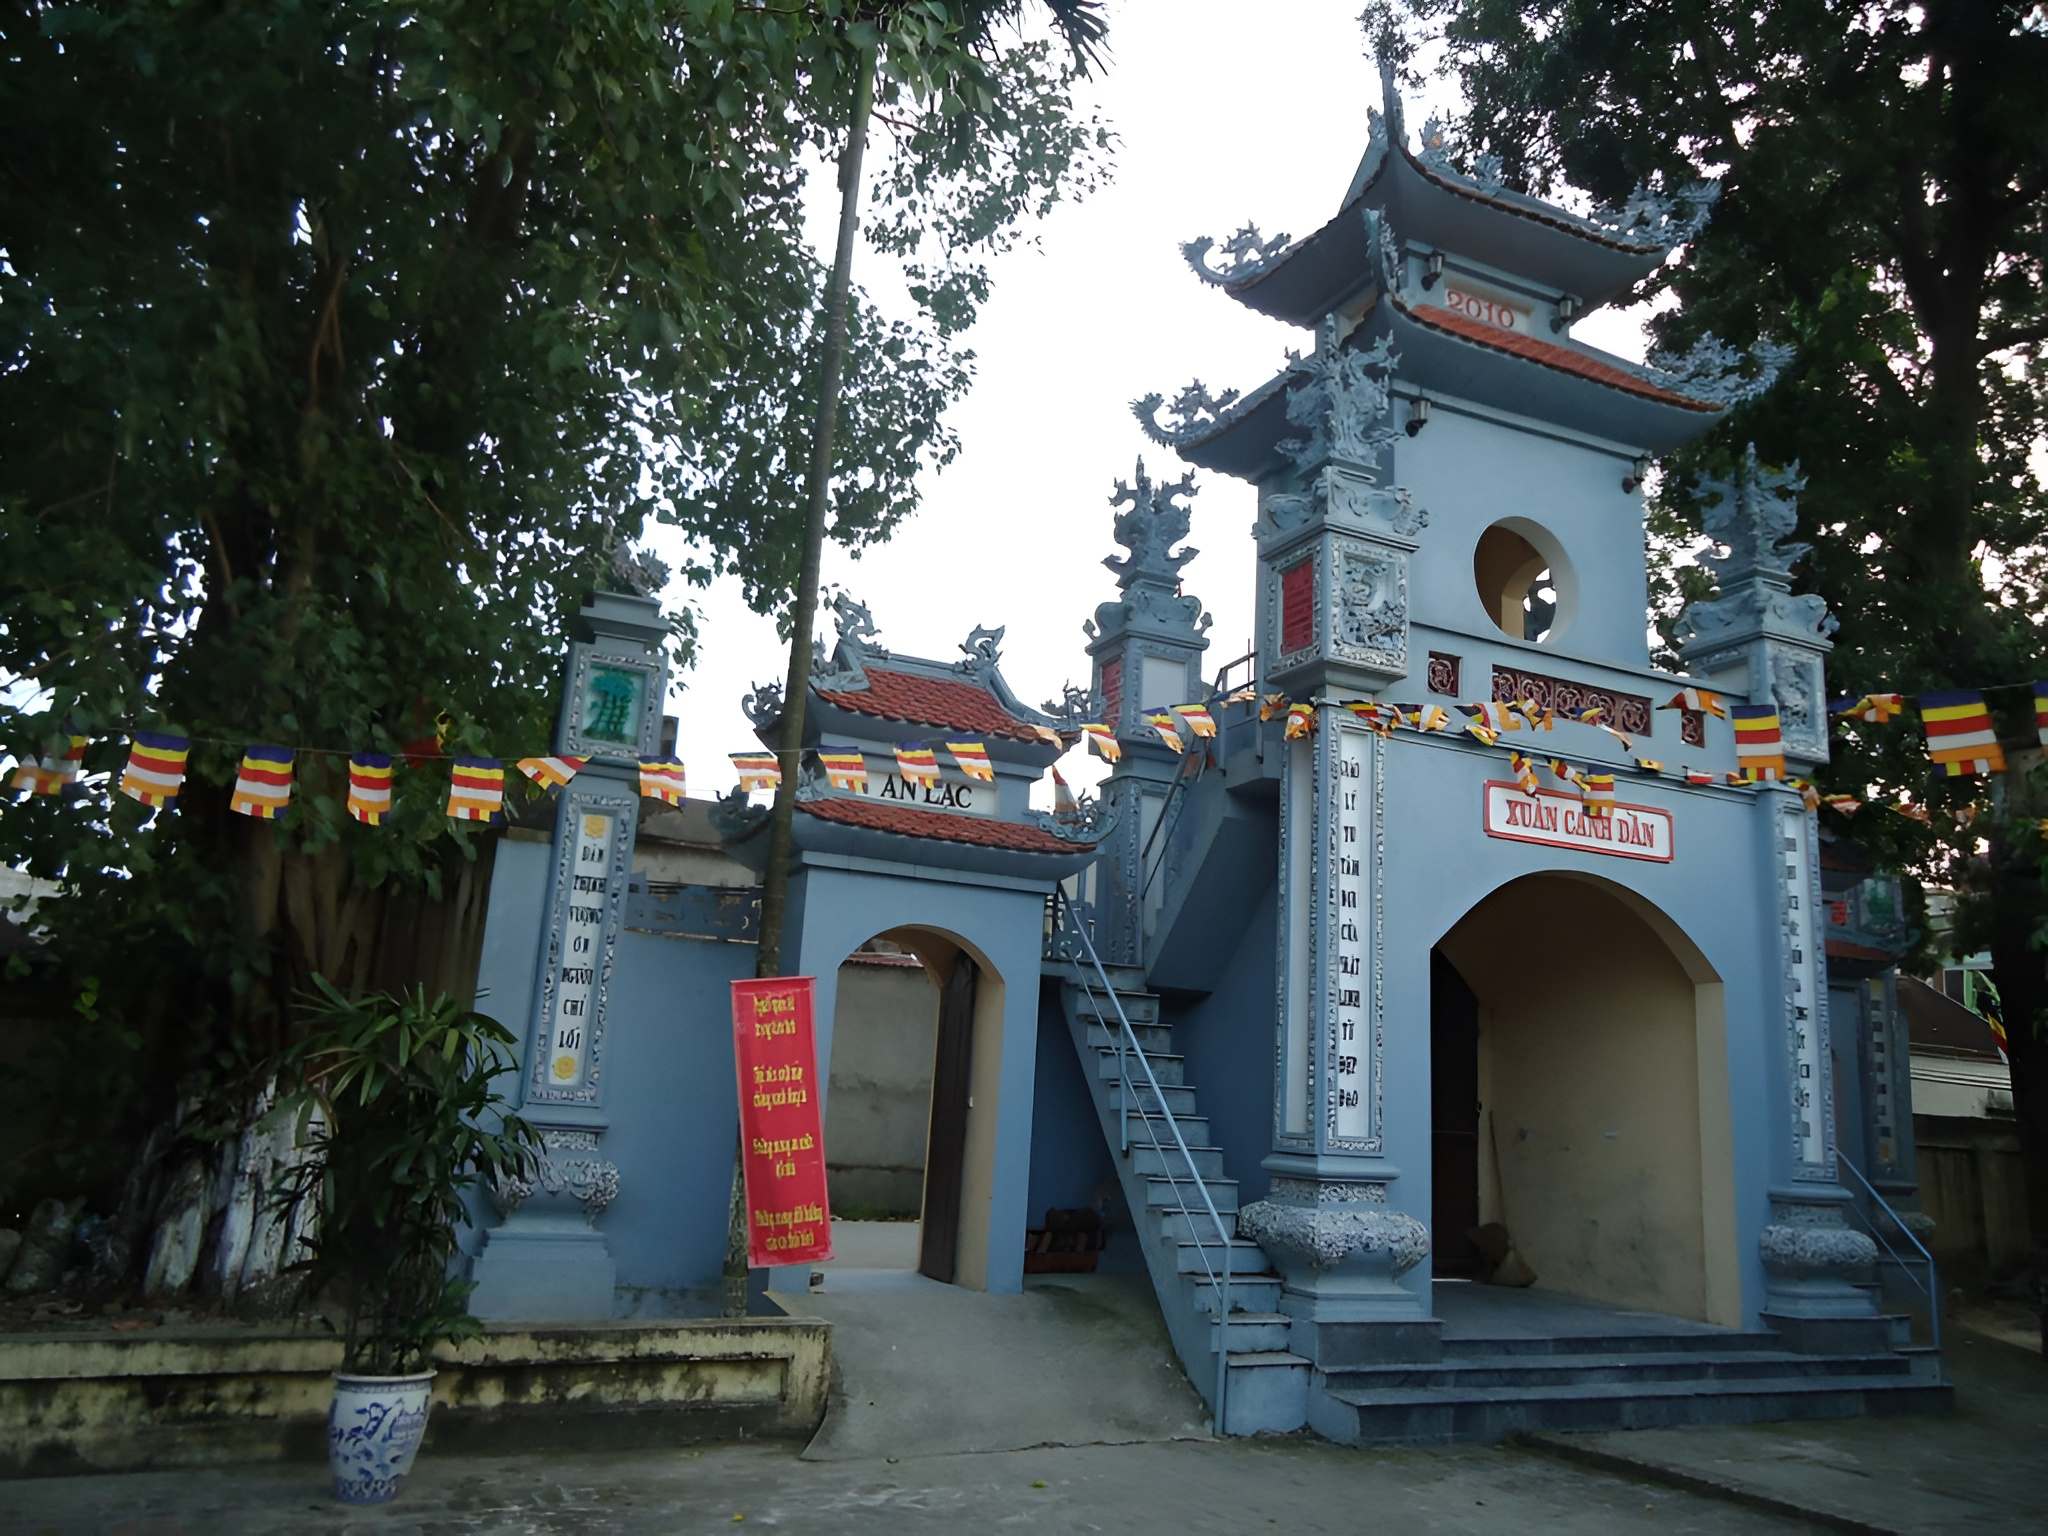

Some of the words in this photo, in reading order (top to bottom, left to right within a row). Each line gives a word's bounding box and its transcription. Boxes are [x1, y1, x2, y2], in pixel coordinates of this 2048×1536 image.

[1447, 289, 1515, 328] 2010
[880, 773, 917, 801] AN
[1564, 809, 1613, 841] CANH
